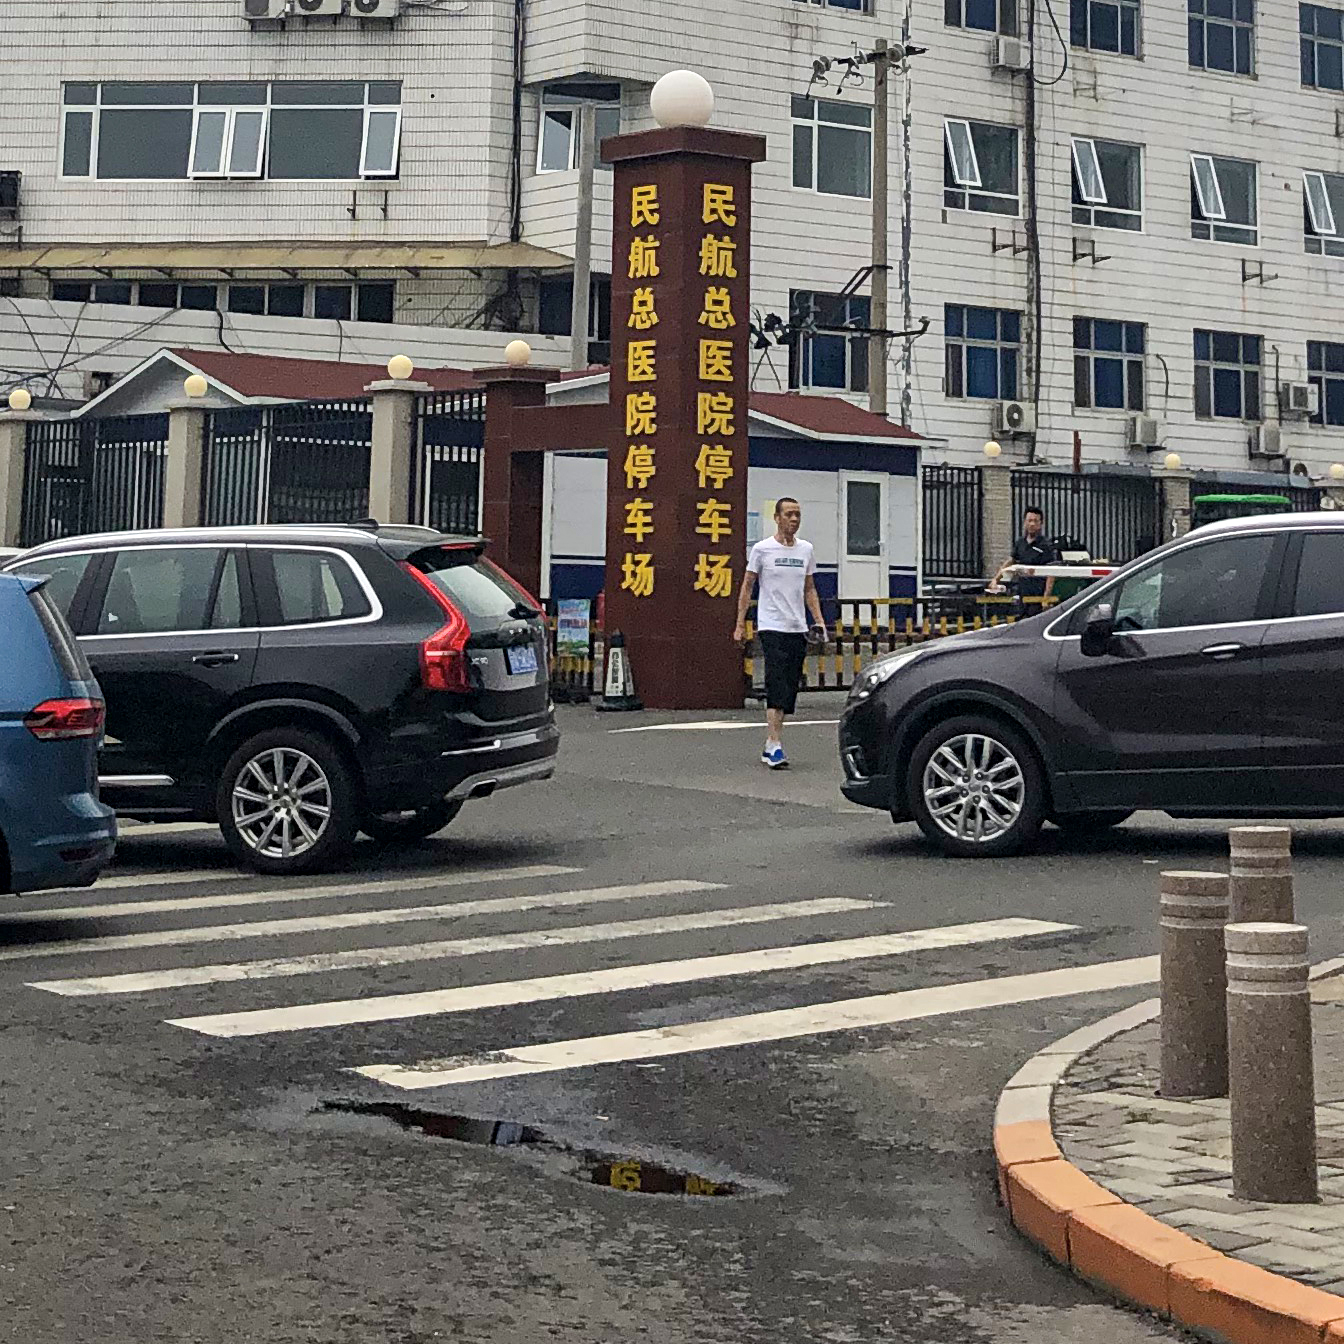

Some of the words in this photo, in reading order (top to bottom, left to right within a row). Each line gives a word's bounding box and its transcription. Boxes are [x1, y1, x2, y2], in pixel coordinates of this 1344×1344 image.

[621, 184, 660, 598] 民航总医院停车场
[693, 182, 737, 598] 民航总医院停车场
